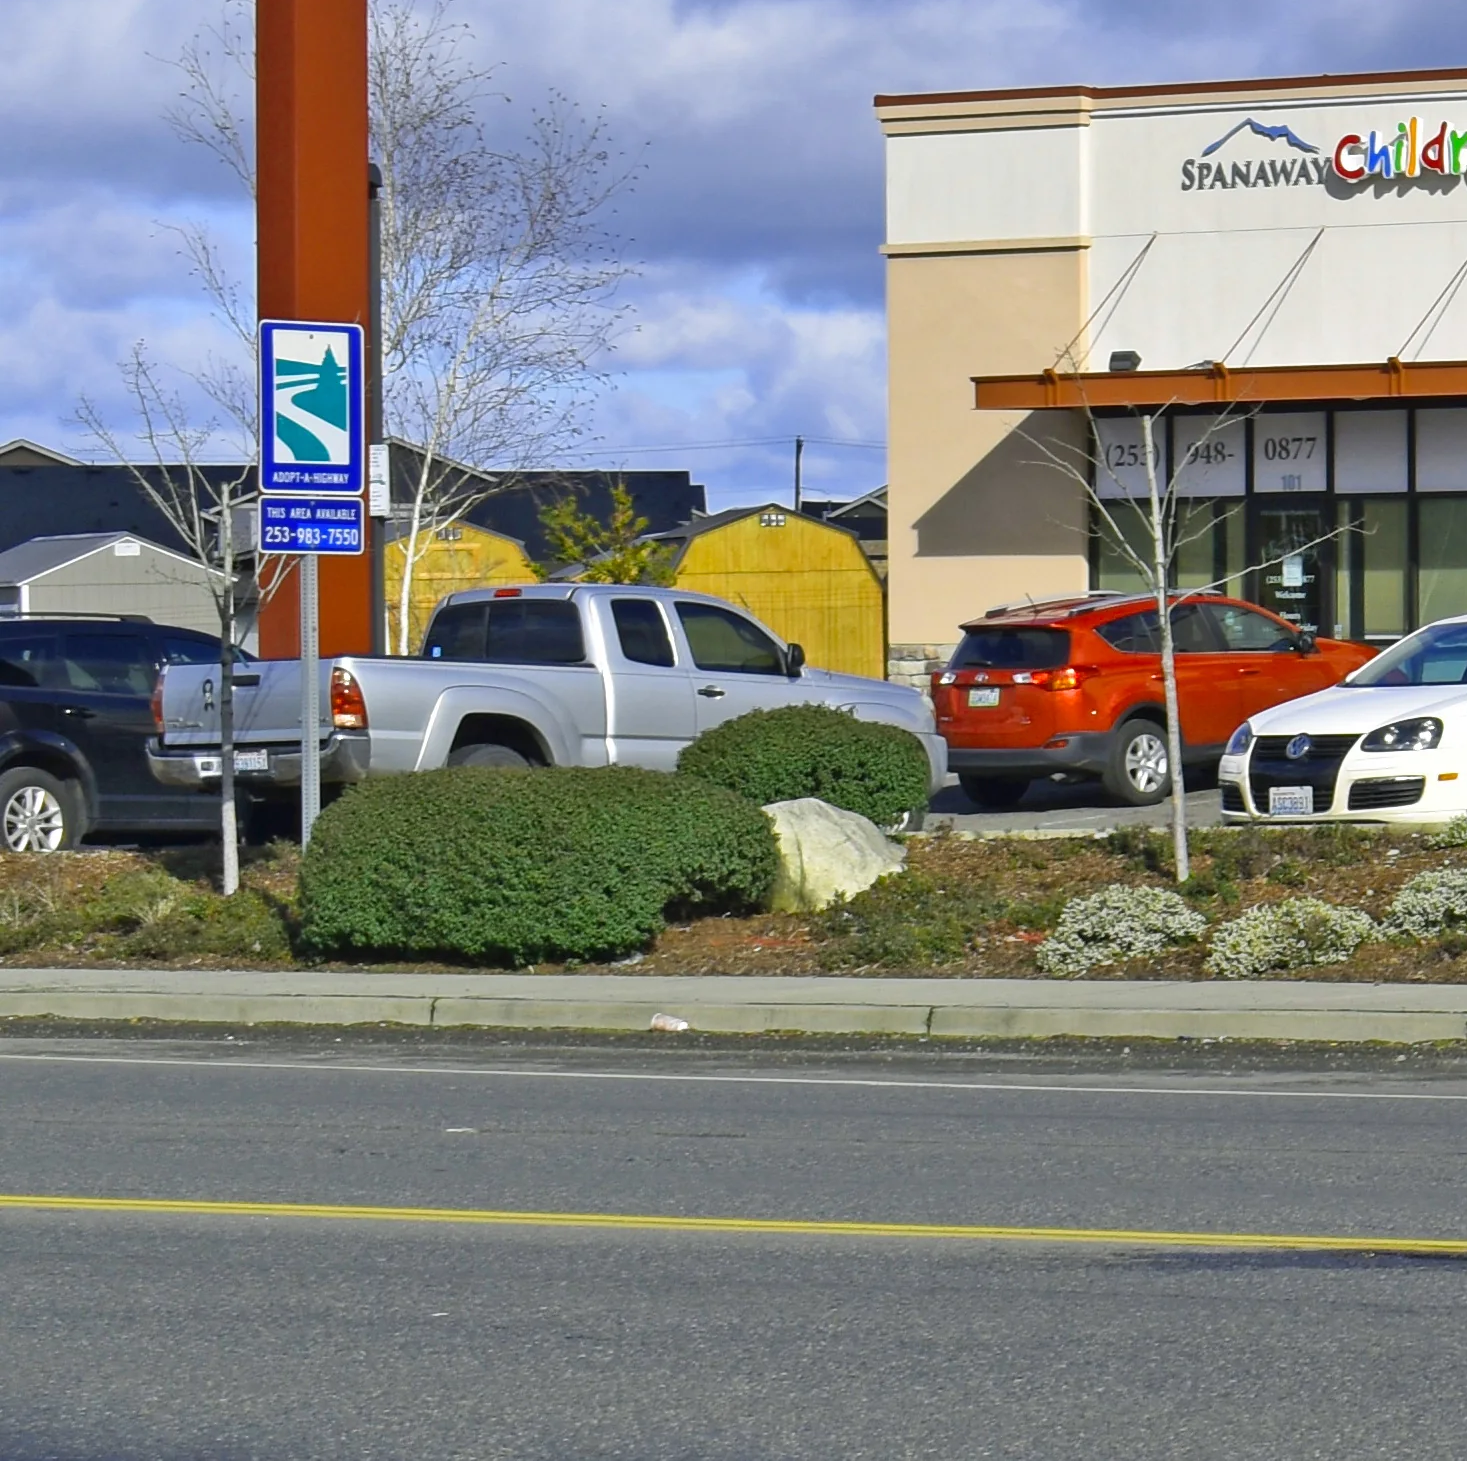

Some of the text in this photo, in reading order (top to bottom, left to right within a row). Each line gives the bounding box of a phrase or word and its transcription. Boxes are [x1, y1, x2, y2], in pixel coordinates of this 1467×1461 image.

[1182, 157, 1333, 191] SPANAWAY
[1186, 440, 1234, 465] 948-
[1264, 436, 1318, 461] 0877
[272, 471, 349, 484] ADOPT-A-HIGHWAY
[1281, 473, 1302, 490] 101
[267, 506, 357, 521] THIS AREA AVAILABLE
[265, 526, 359, 546] 253-983-7550
